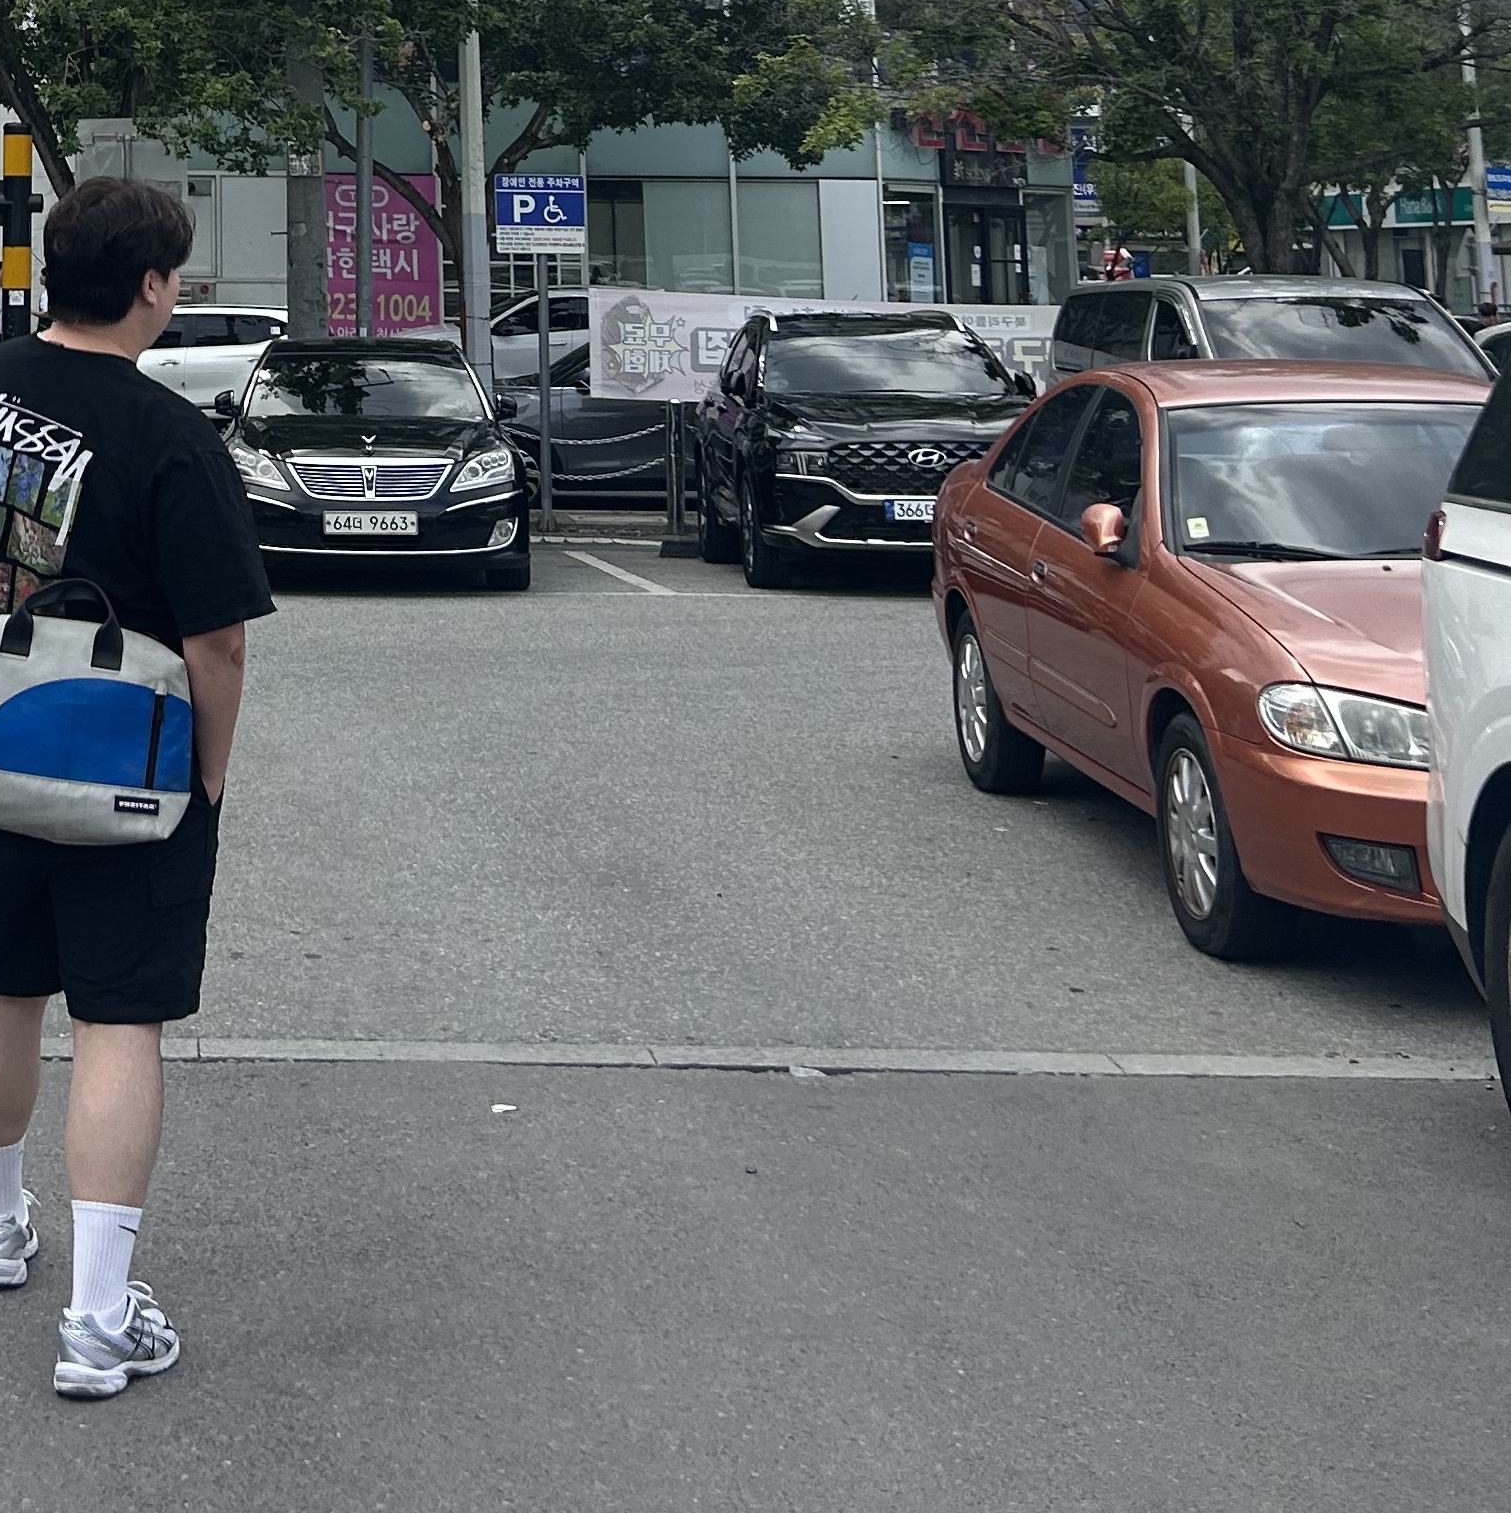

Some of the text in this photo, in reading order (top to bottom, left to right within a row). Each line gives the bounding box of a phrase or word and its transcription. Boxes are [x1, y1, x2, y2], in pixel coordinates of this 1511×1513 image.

[513, 194, 536, 223] P
[376, 293, 433, 322] 1004
[369, 515, 408, 531] 9663
